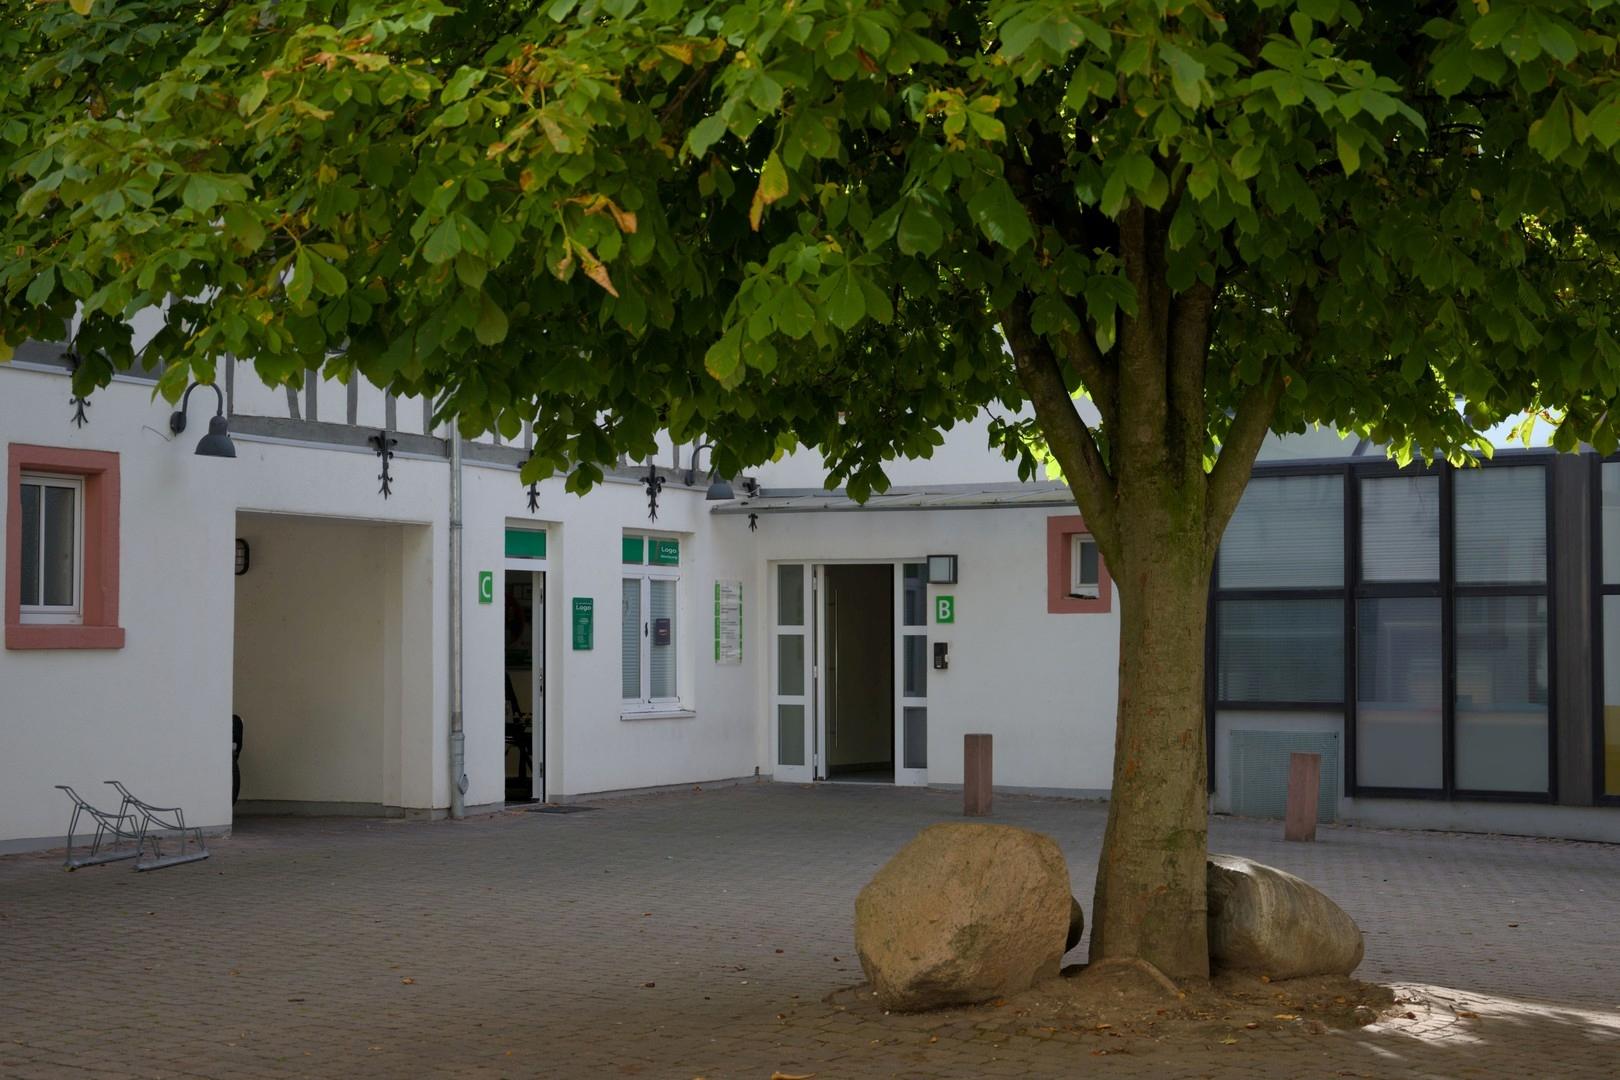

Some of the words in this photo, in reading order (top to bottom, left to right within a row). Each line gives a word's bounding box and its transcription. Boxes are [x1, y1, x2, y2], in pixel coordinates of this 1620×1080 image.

[661, 546, 677, 554] Logo
[482, 576, 491, 598] C
[939, 600, 951, 619] B
